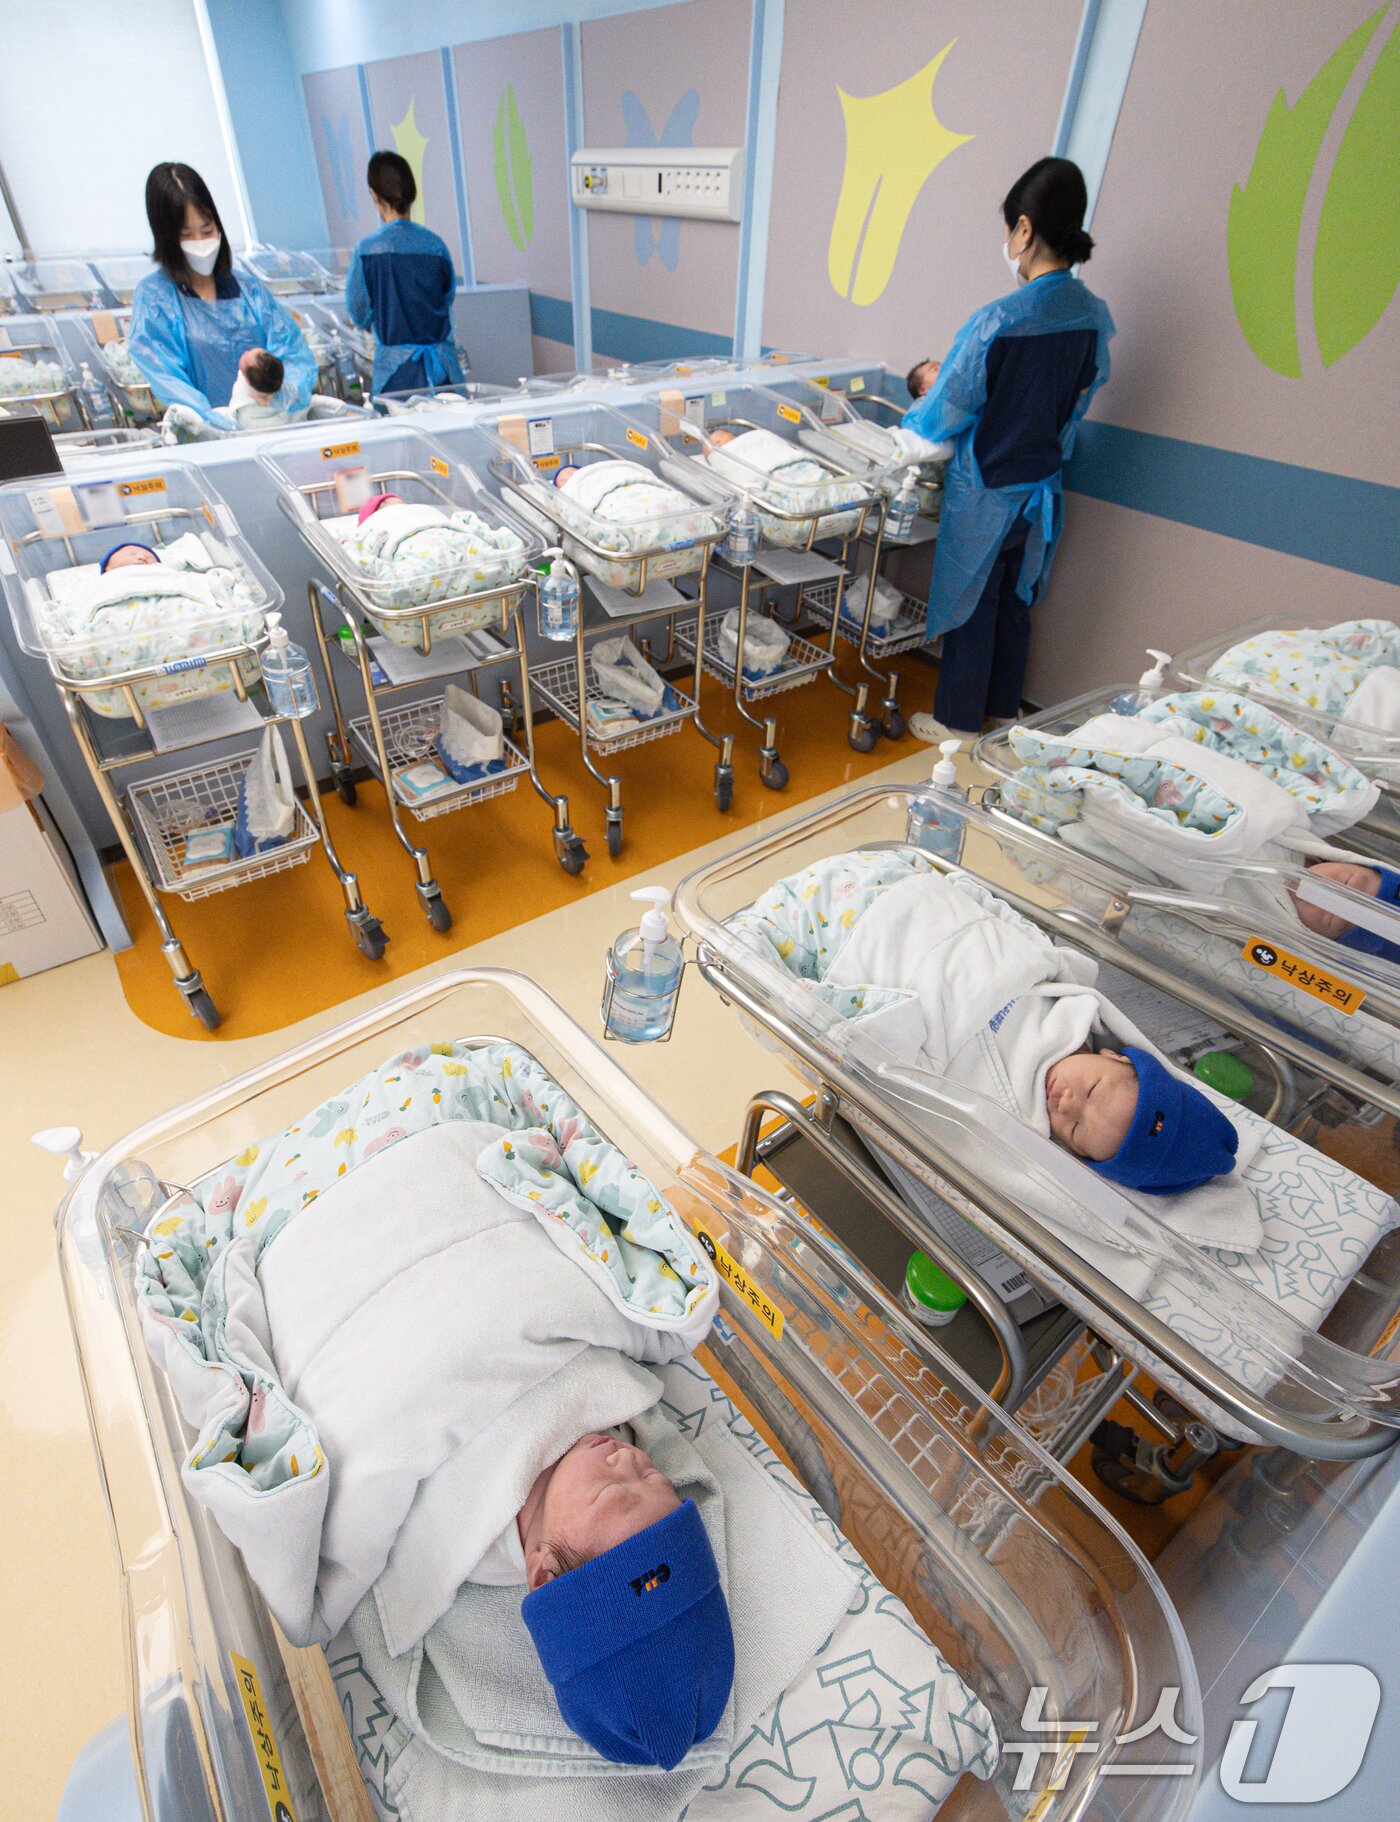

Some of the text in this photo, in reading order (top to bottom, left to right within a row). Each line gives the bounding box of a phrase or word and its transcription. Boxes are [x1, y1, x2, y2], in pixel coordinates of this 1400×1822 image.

[1280, 958, 1353, 1007] 낙상주의
[719, 1255, 776, 1327] 낙상주의
[239, 1668, 281, 1792] 낙상주의
